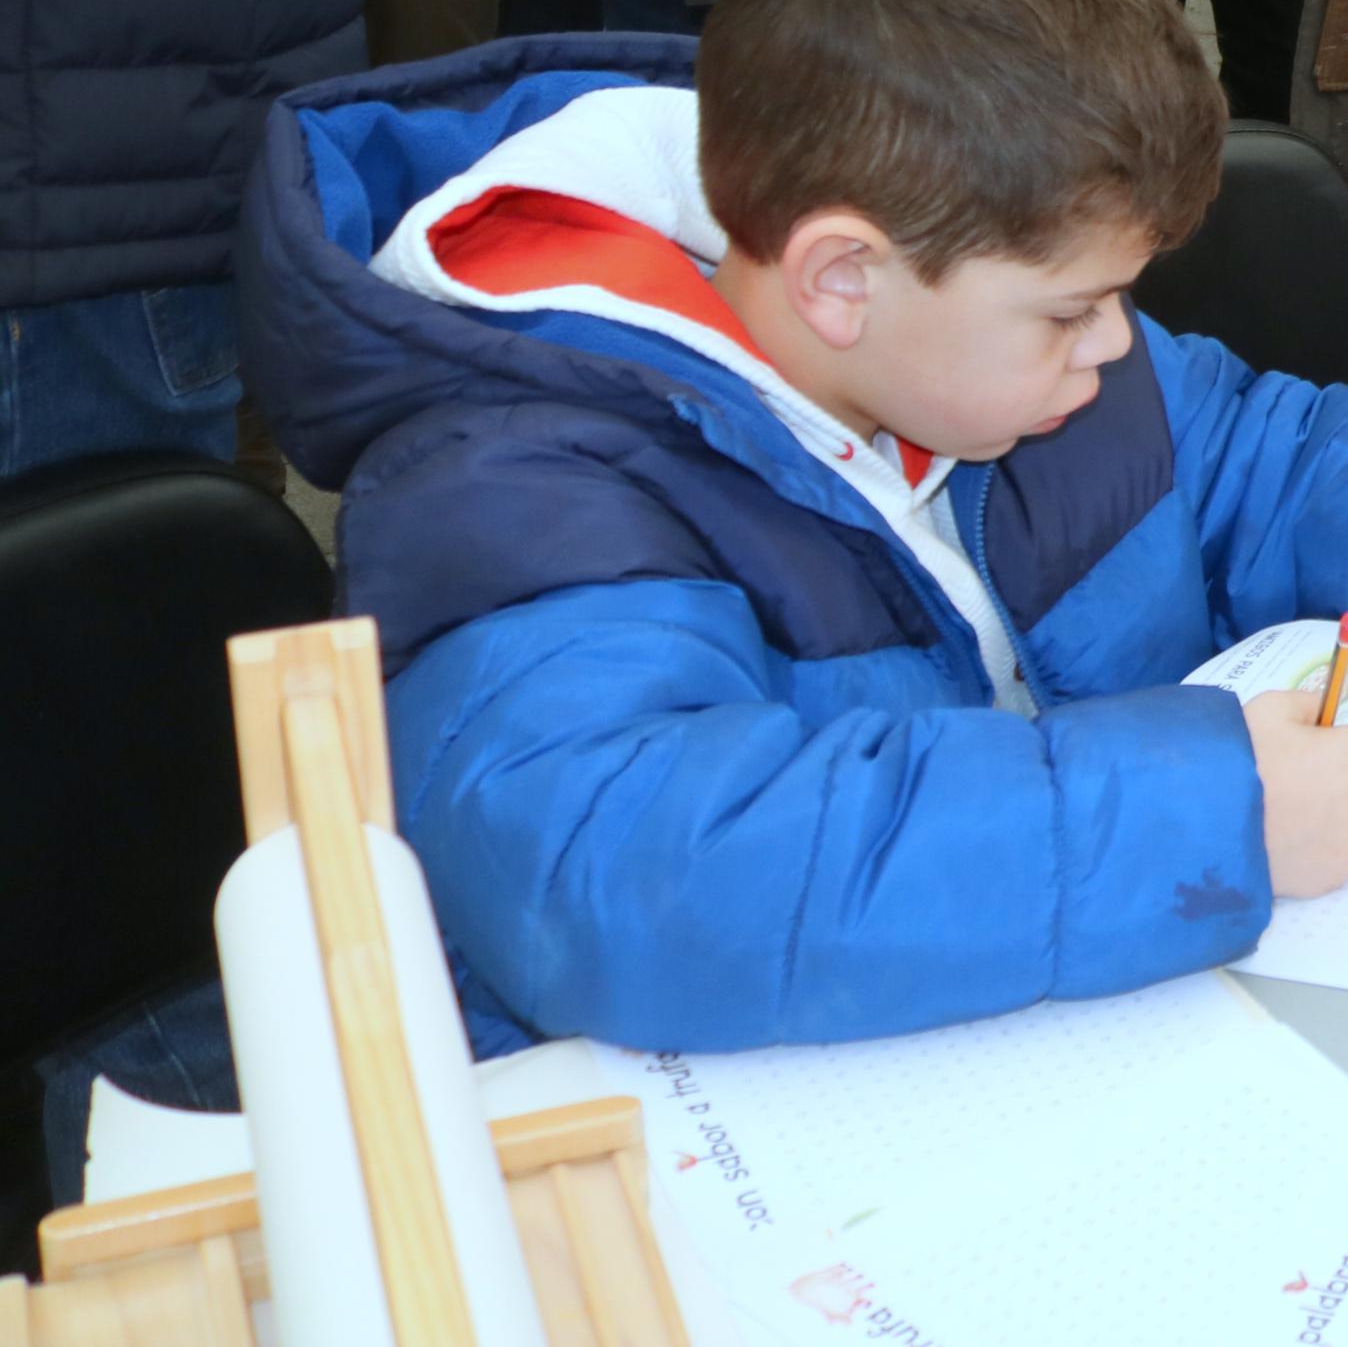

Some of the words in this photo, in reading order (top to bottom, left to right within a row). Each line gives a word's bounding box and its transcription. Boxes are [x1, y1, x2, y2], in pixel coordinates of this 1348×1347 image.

[1245, 631, 1284, 658] AMIGOS
[1224, 660, 1254, 680] PARA
[685, 1101, 710, 1115] a
[695, 1121, 751, 1182] sabor
